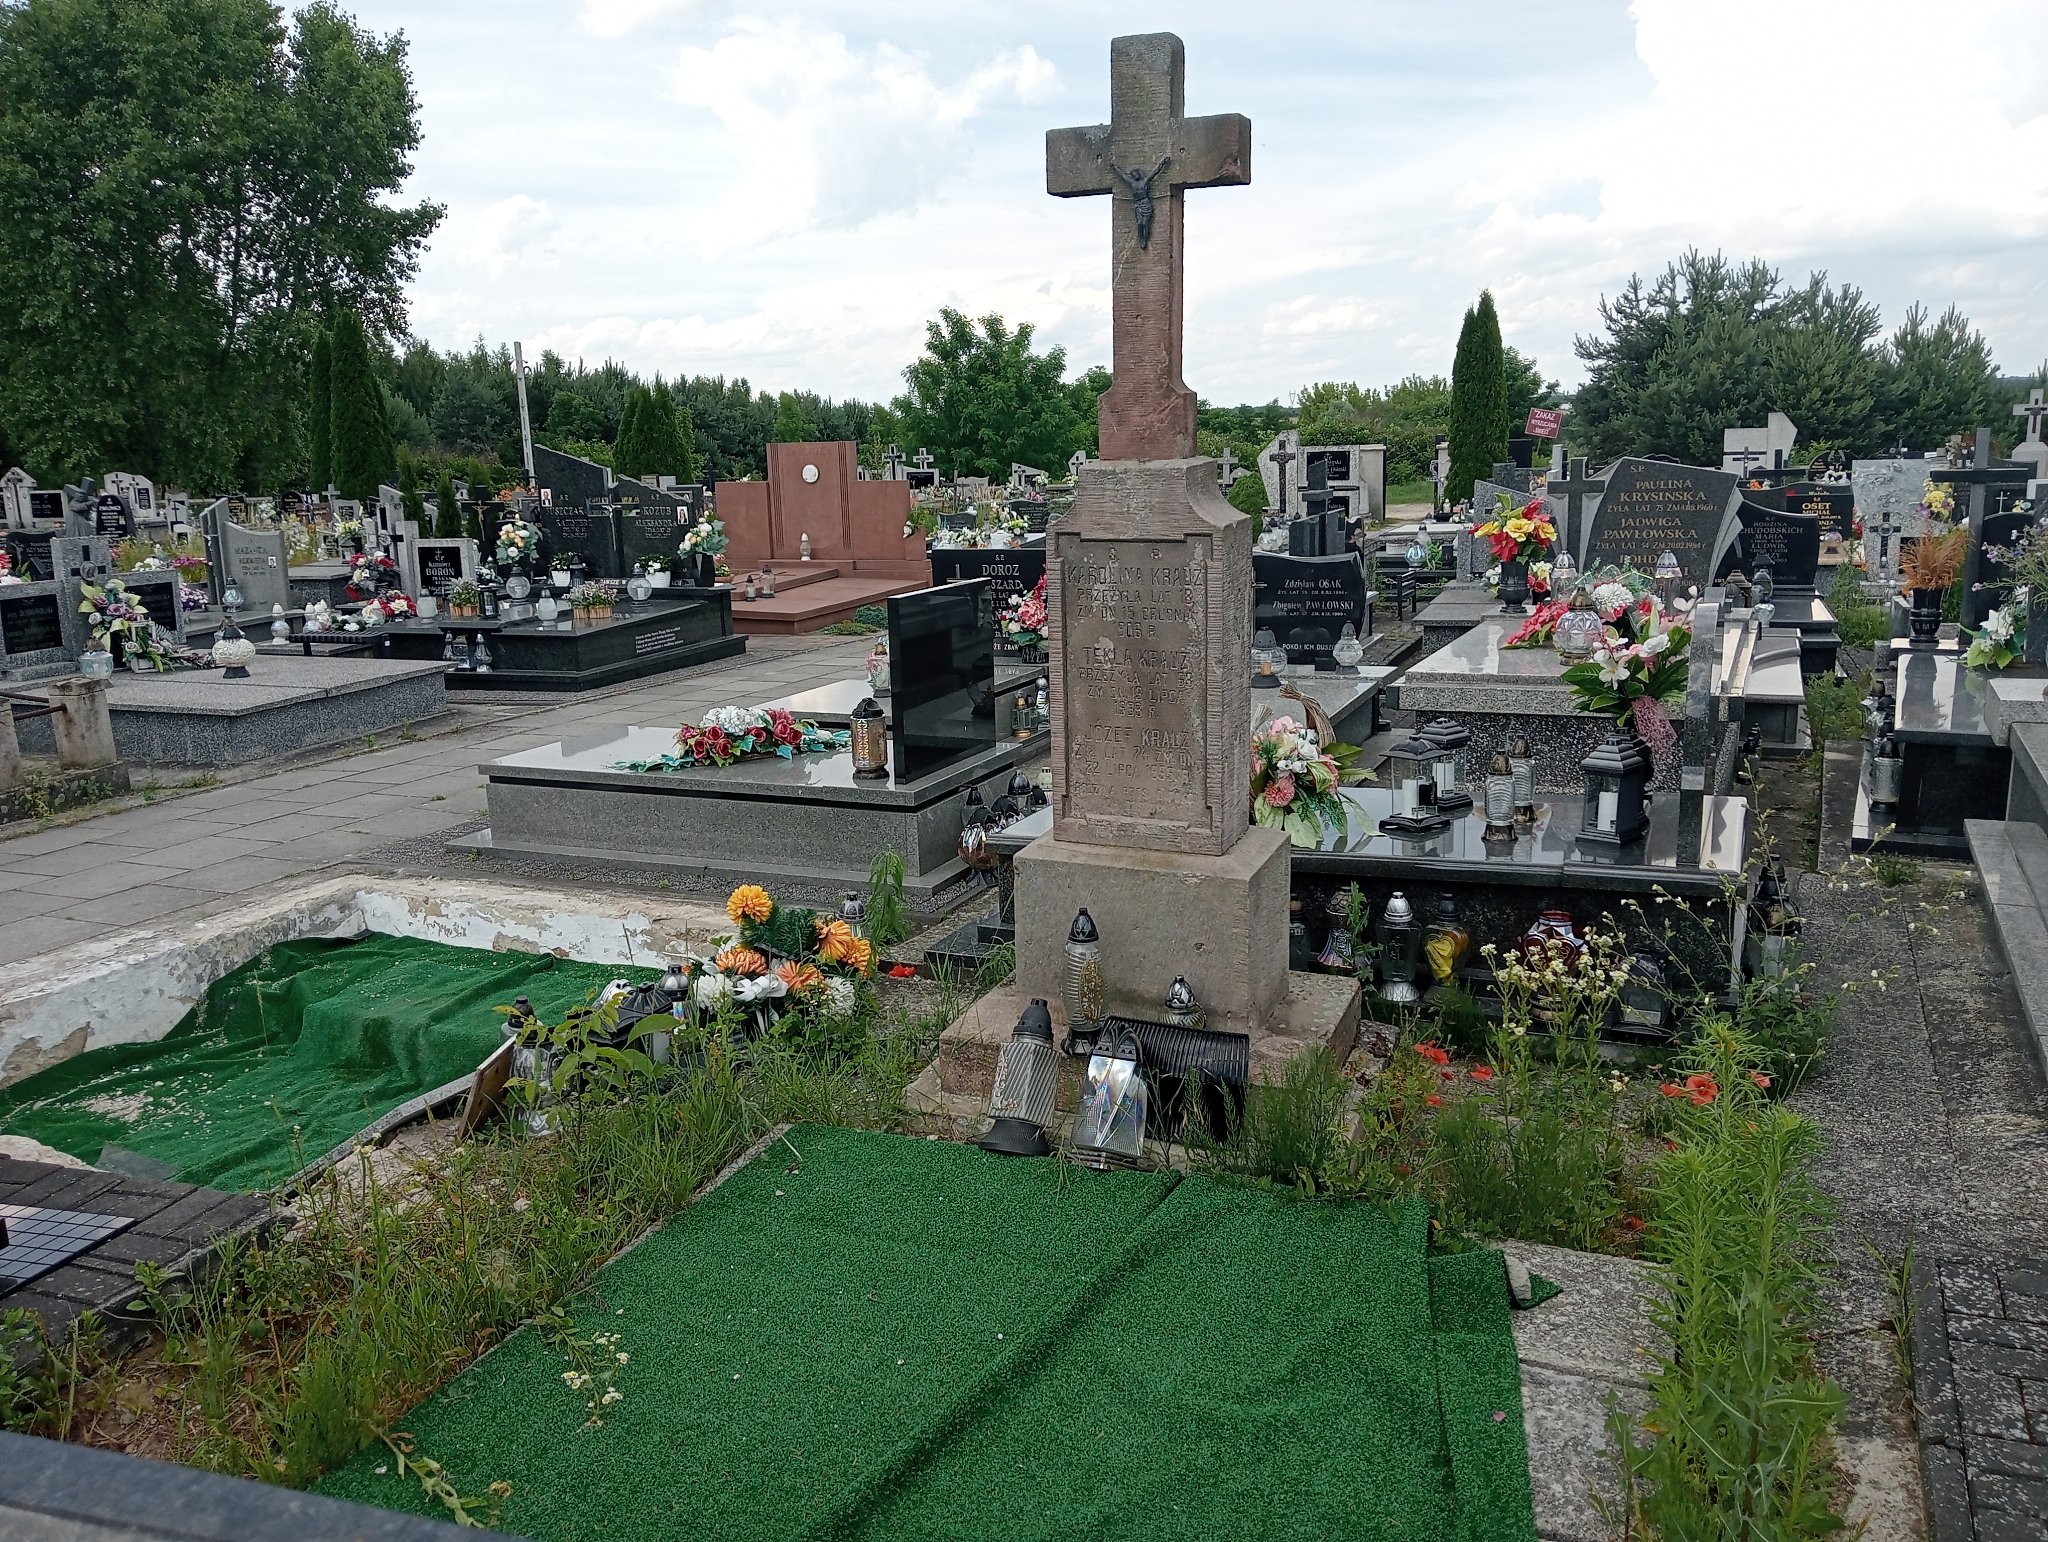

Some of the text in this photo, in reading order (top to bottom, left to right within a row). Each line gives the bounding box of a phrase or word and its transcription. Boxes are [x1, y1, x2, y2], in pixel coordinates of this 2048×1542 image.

[1535, 410, 1556, 420] ZAKAZ
[1636, 479, 1693, 490] PAULINA
[643, 506, 672, 516] KOZUB
[1635, 504, 1651, 512] LAT
[1656, 504, 1664, 512] 75
[1801, 502, 1832, 510] OSET
[1621, 517, 1682, 528] JADWIGA
[1602, 529, 1698, 539] PAWŁOWSKA
[1621, 541, 1637, 549] LAT
[981, 564, 1020, 576] DOROZ
[990, 579, 1021, 590] SZARD
[1318, 579, 1342, 589] OSAK
[1272, 600, 1354, 611] Zbigniew PAWŁOWSKI
[1141, 727, 1191, 749] KRAUZ
